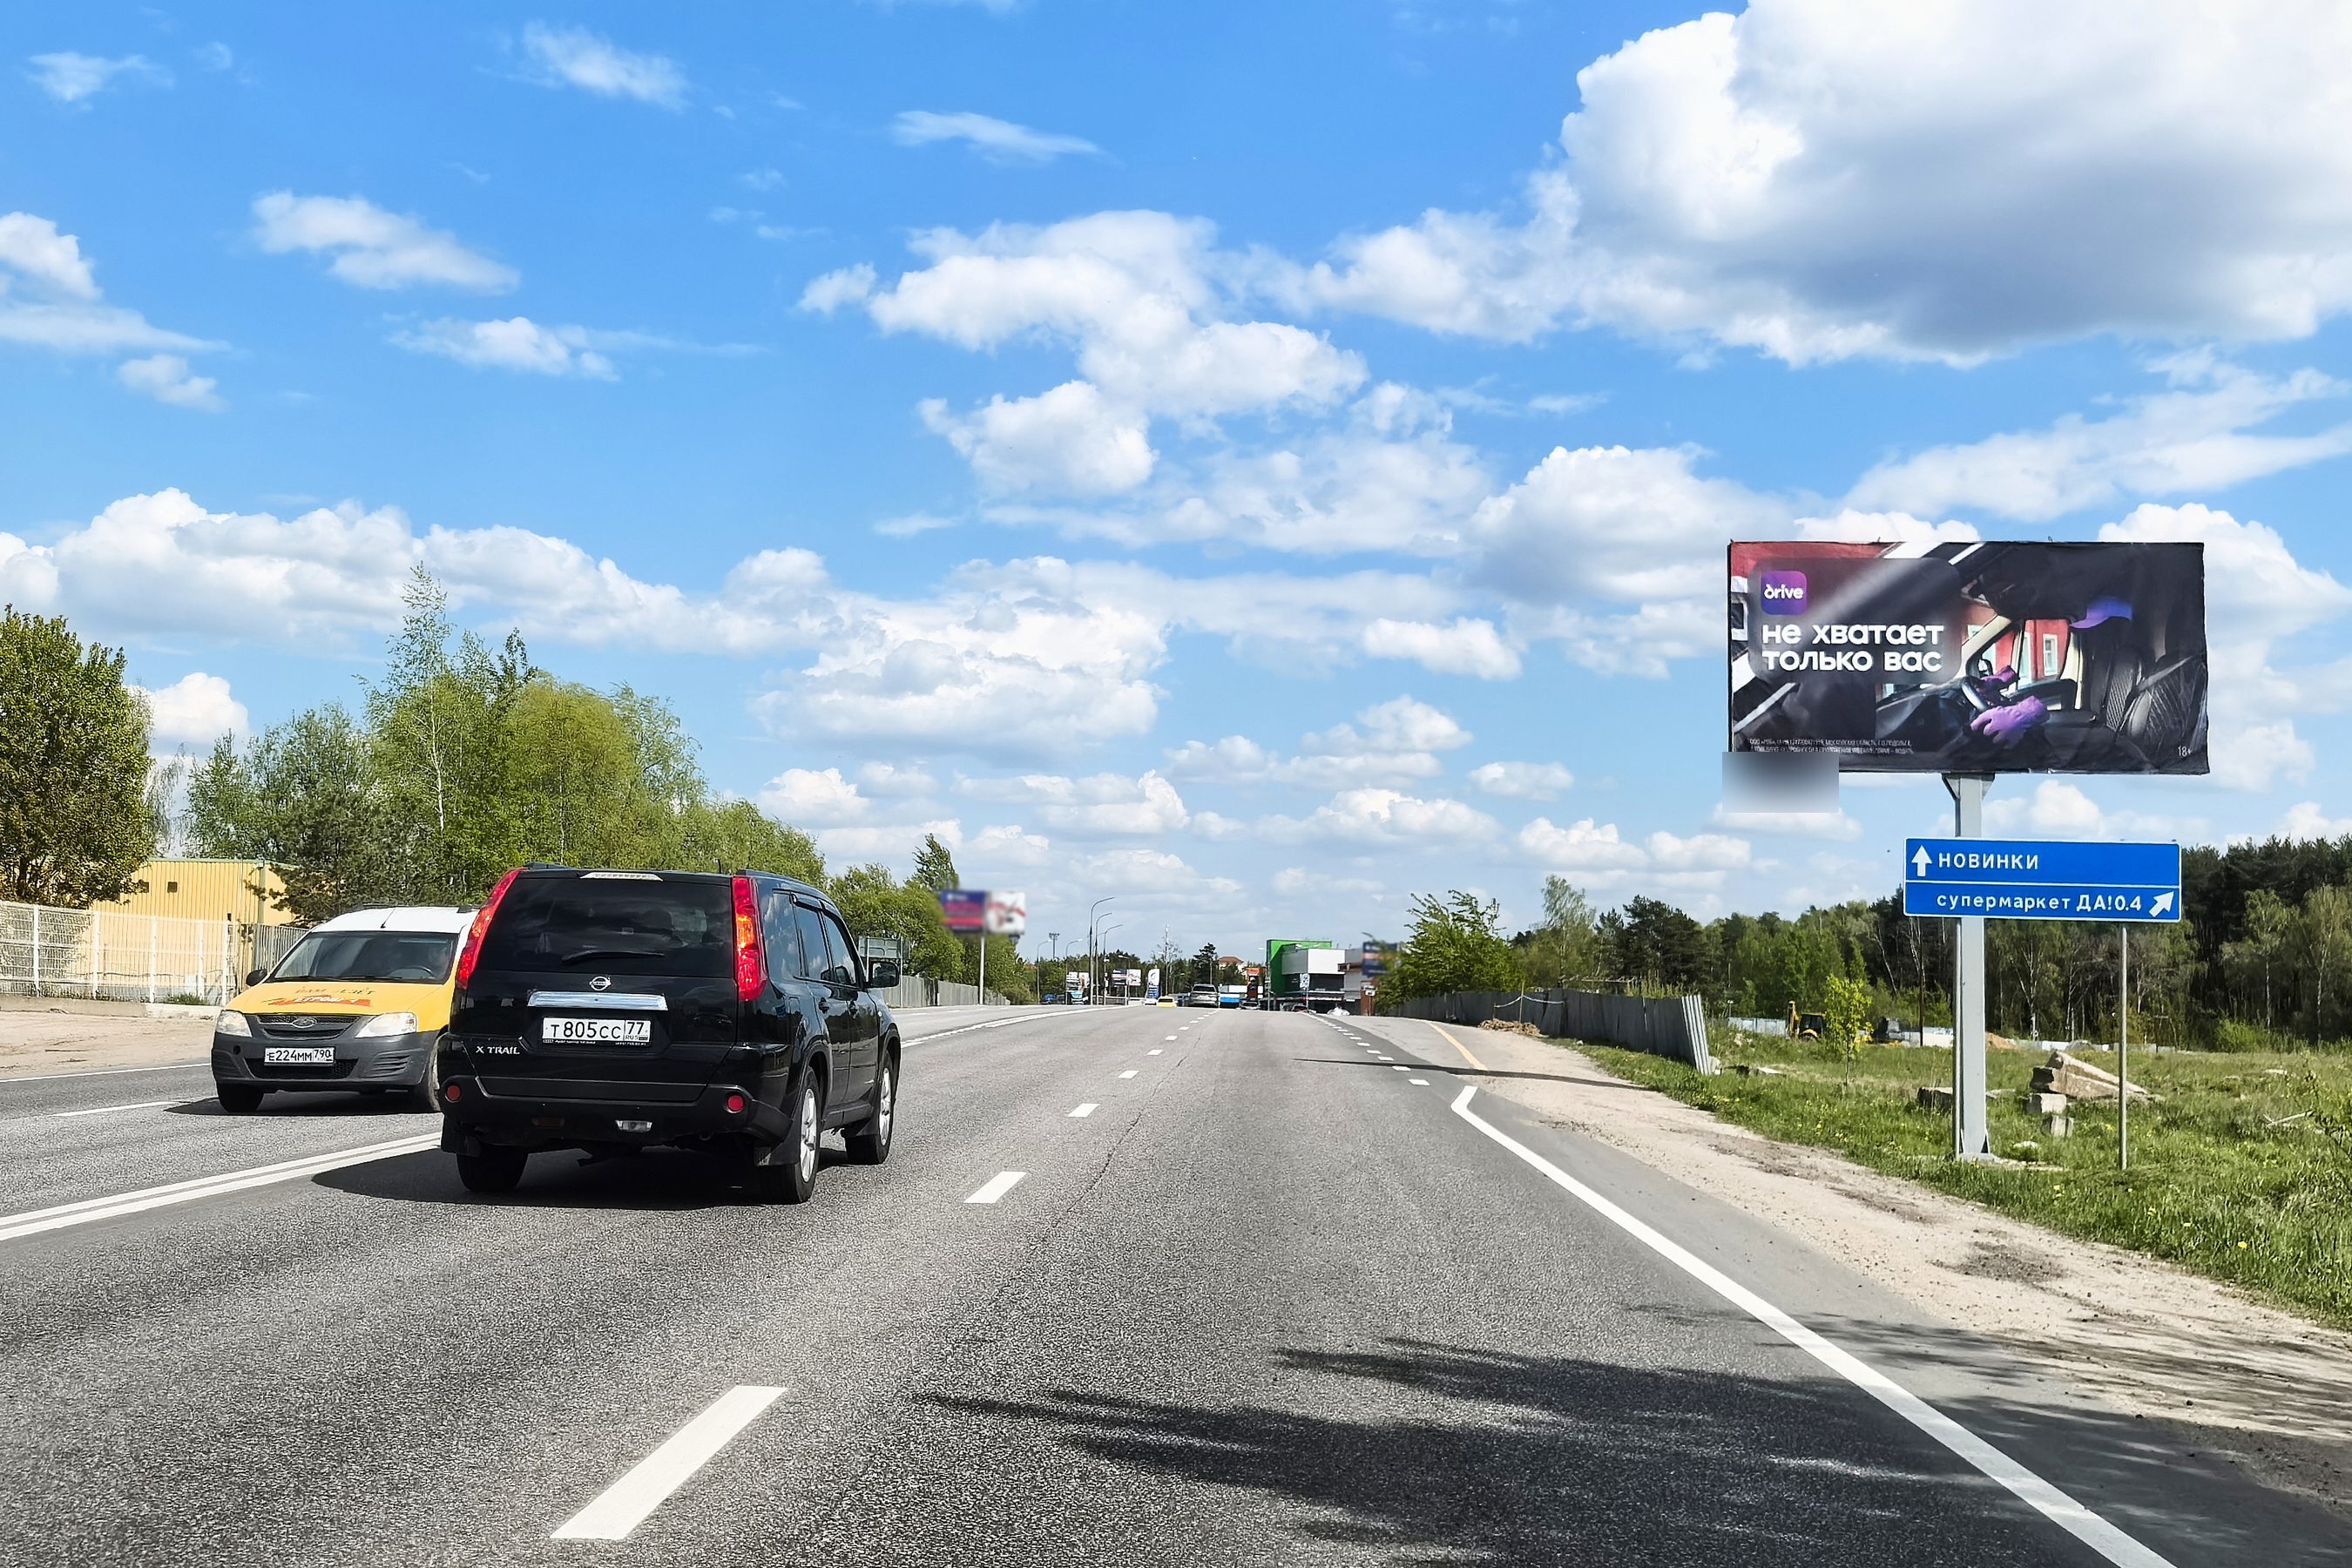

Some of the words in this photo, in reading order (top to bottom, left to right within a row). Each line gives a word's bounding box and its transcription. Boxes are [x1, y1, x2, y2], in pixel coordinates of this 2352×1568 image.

[1763, 584, 1804, 599] drive
[1762, 624, 1801, 645] не
[1812, 624, 1944, 645] хватает
[1761, 651, 1873, 672] только
[1883, 651, 1942, 672] вас
[1938, 852, 2039, 870] НОВИНКИ
[1936, 895, 2071, 913] супермаркет
[476, 1045, 484, 1054] X
[488, 1045, 521, 1055] TRAIL
